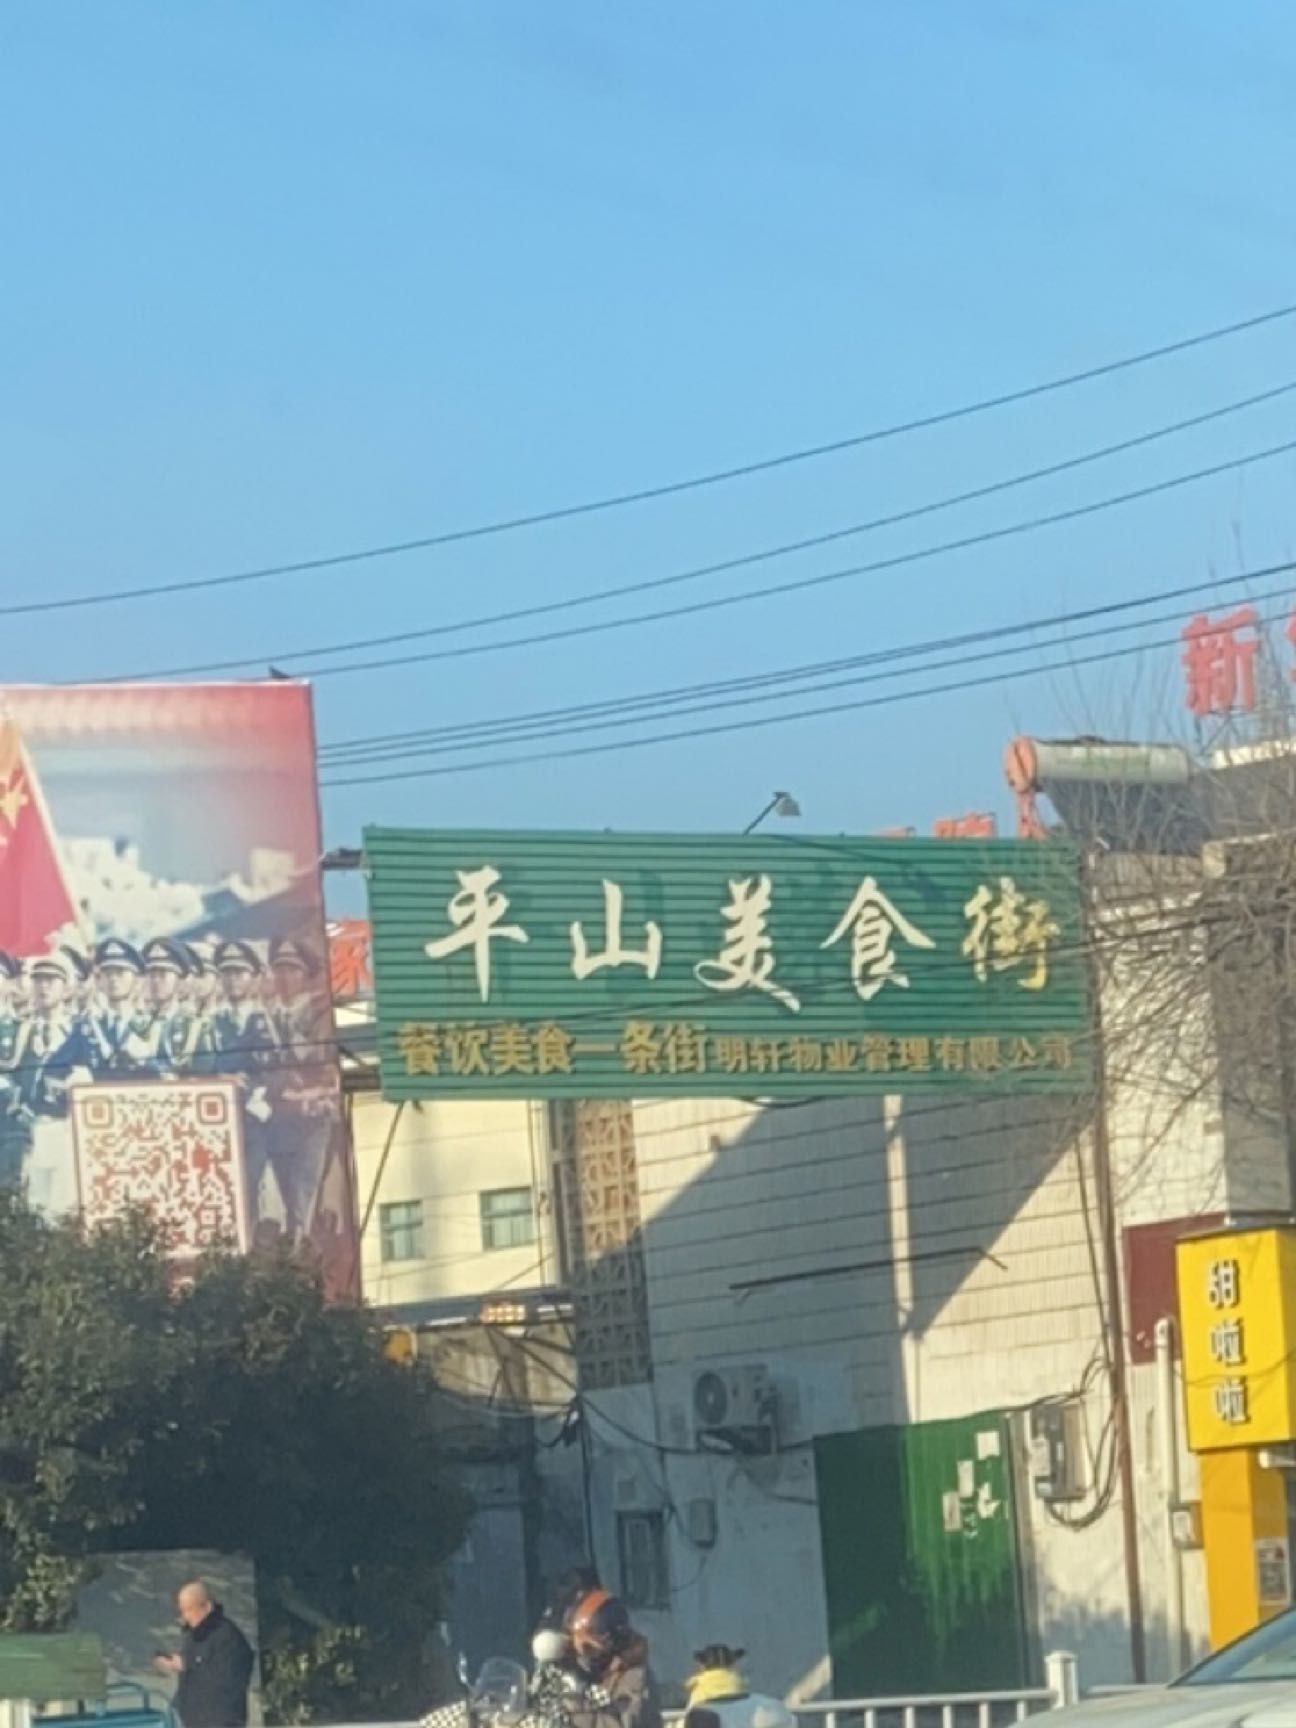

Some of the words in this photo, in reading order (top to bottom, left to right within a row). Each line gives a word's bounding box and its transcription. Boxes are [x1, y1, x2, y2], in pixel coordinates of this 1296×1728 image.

[424, 864, 1062, 1013] 平山美食街
[399, 1019, 707, 1077] 餐饮美食一条街
[1206, 1260, 1249, 1423] 甜啦啦
